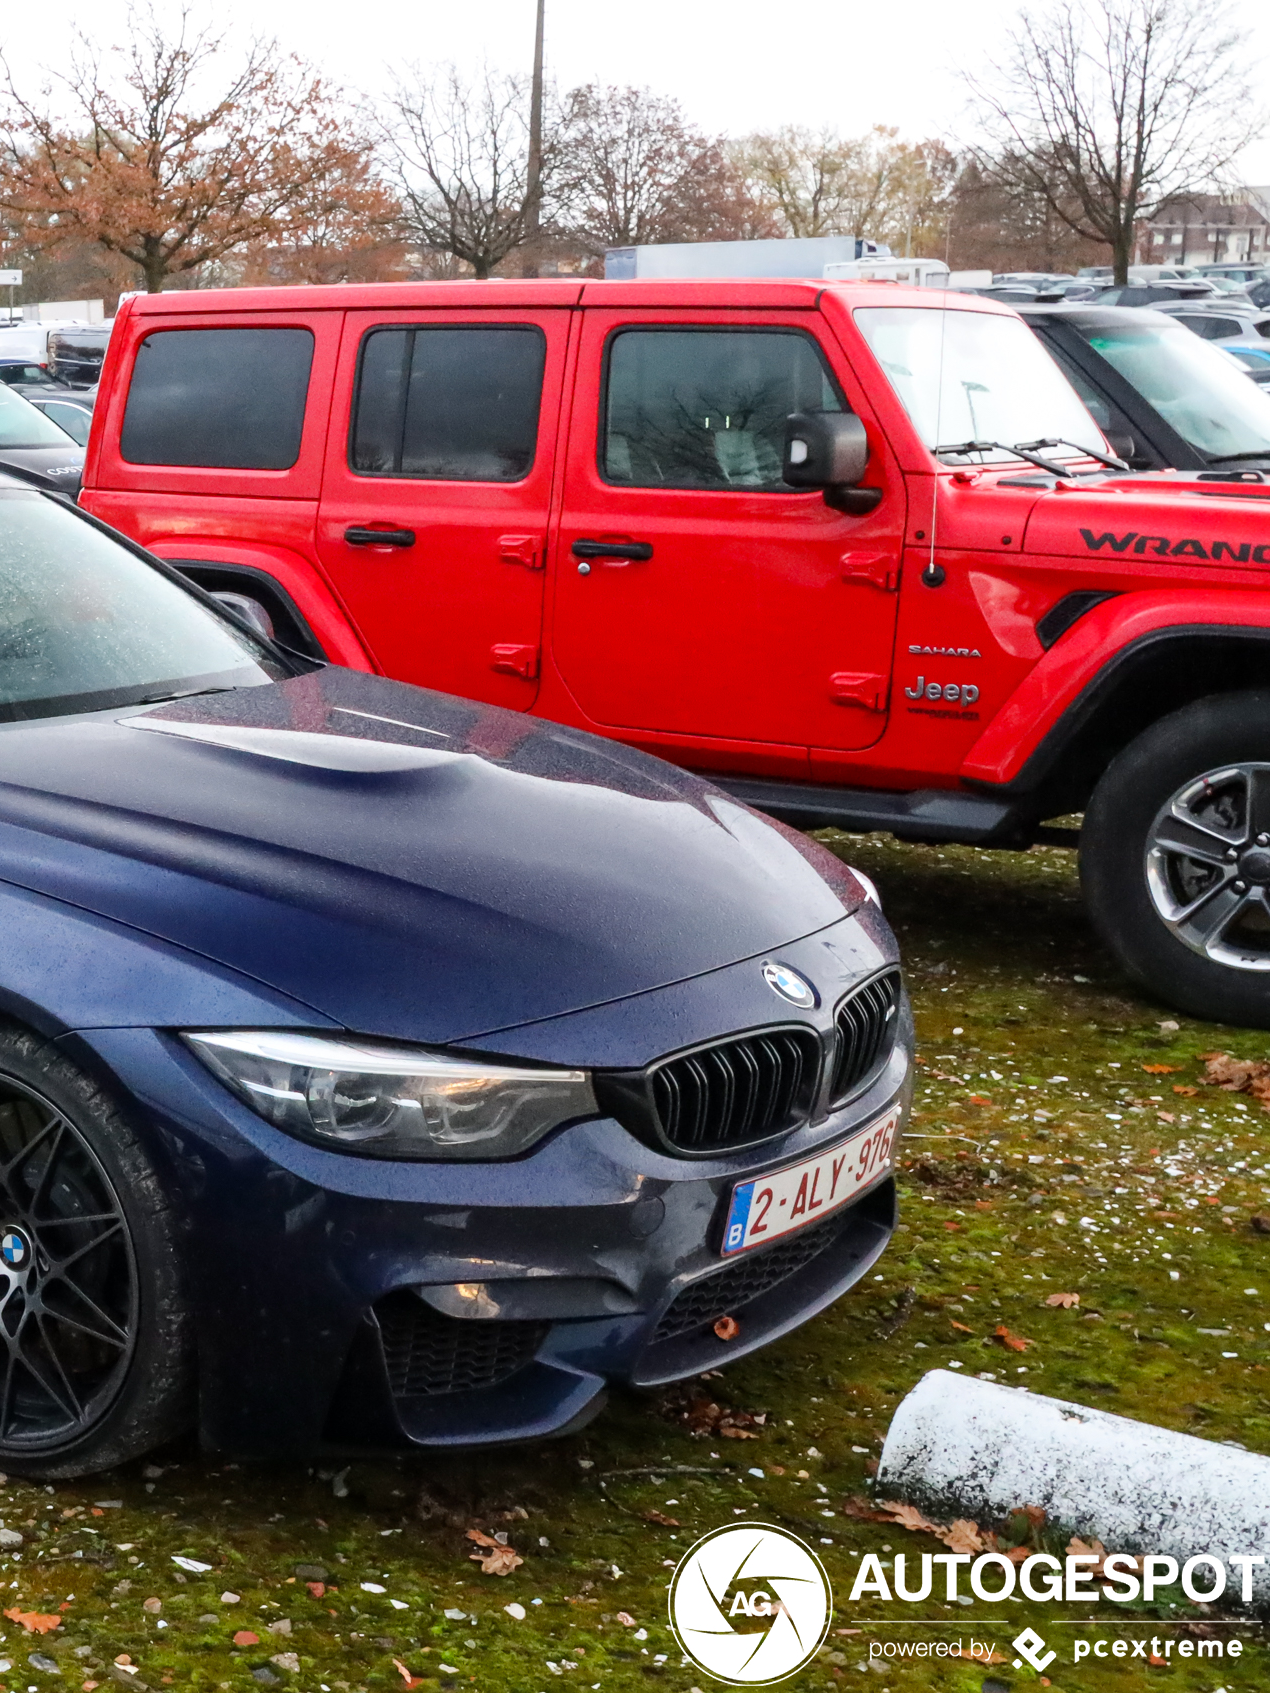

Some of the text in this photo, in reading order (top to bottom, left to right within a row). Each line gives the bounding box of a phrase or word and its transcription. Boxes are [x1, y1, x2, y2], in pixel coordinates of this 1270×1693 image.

[908, 645, 982, 658] SAHARA
[904, 675, 980, 708] Jeep
[749, 1119, 894, 1237] 2-ALY-976
[728, 1222, 743, 1246] B
